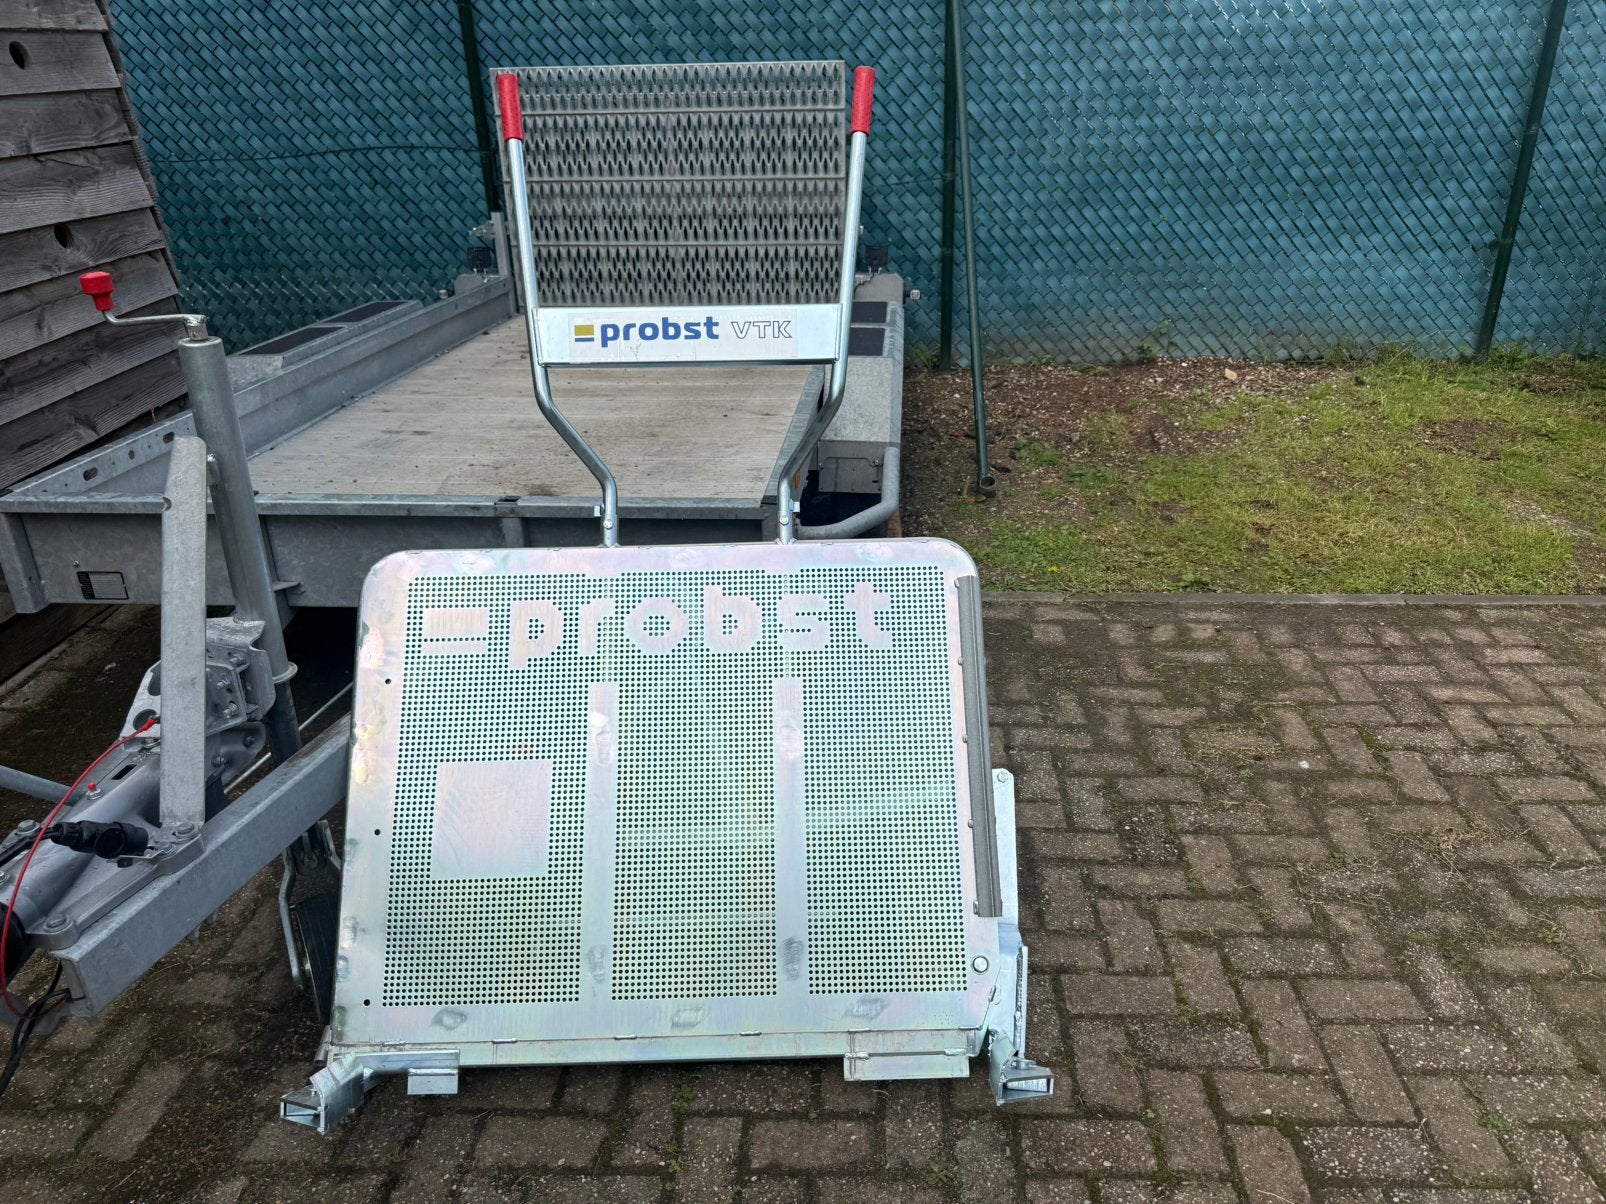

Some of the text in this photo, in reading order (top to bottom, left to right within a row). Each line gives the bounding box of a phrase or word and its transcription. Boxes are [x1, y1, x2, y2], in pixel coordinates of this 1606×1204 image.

[601, 316, 793, 347] probst VTK
[509, 582, 895, 668] probst
